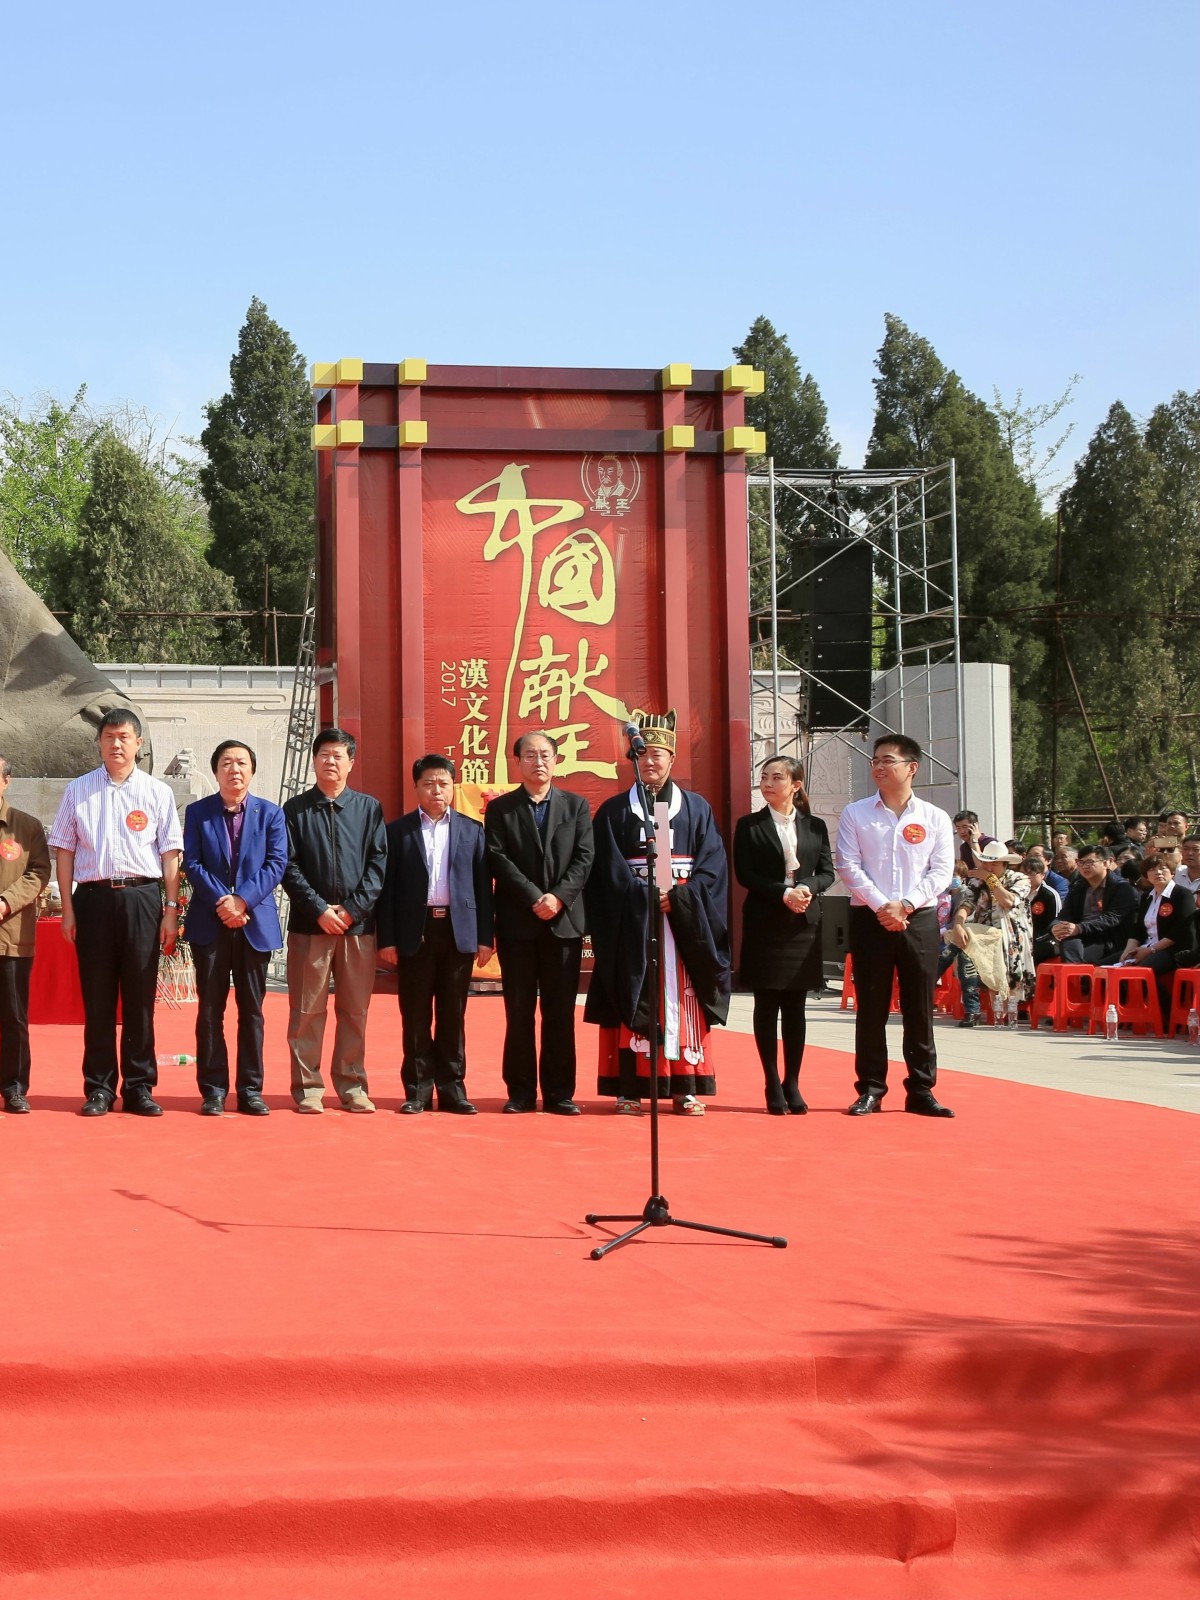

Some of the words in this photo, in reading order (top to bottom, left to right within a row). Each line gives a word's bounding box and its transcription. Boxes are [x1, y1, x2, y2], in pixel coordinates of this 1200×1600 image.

[441, 661, 457, 707] 2017
[459, 658, 490, 784] 漢文化節
